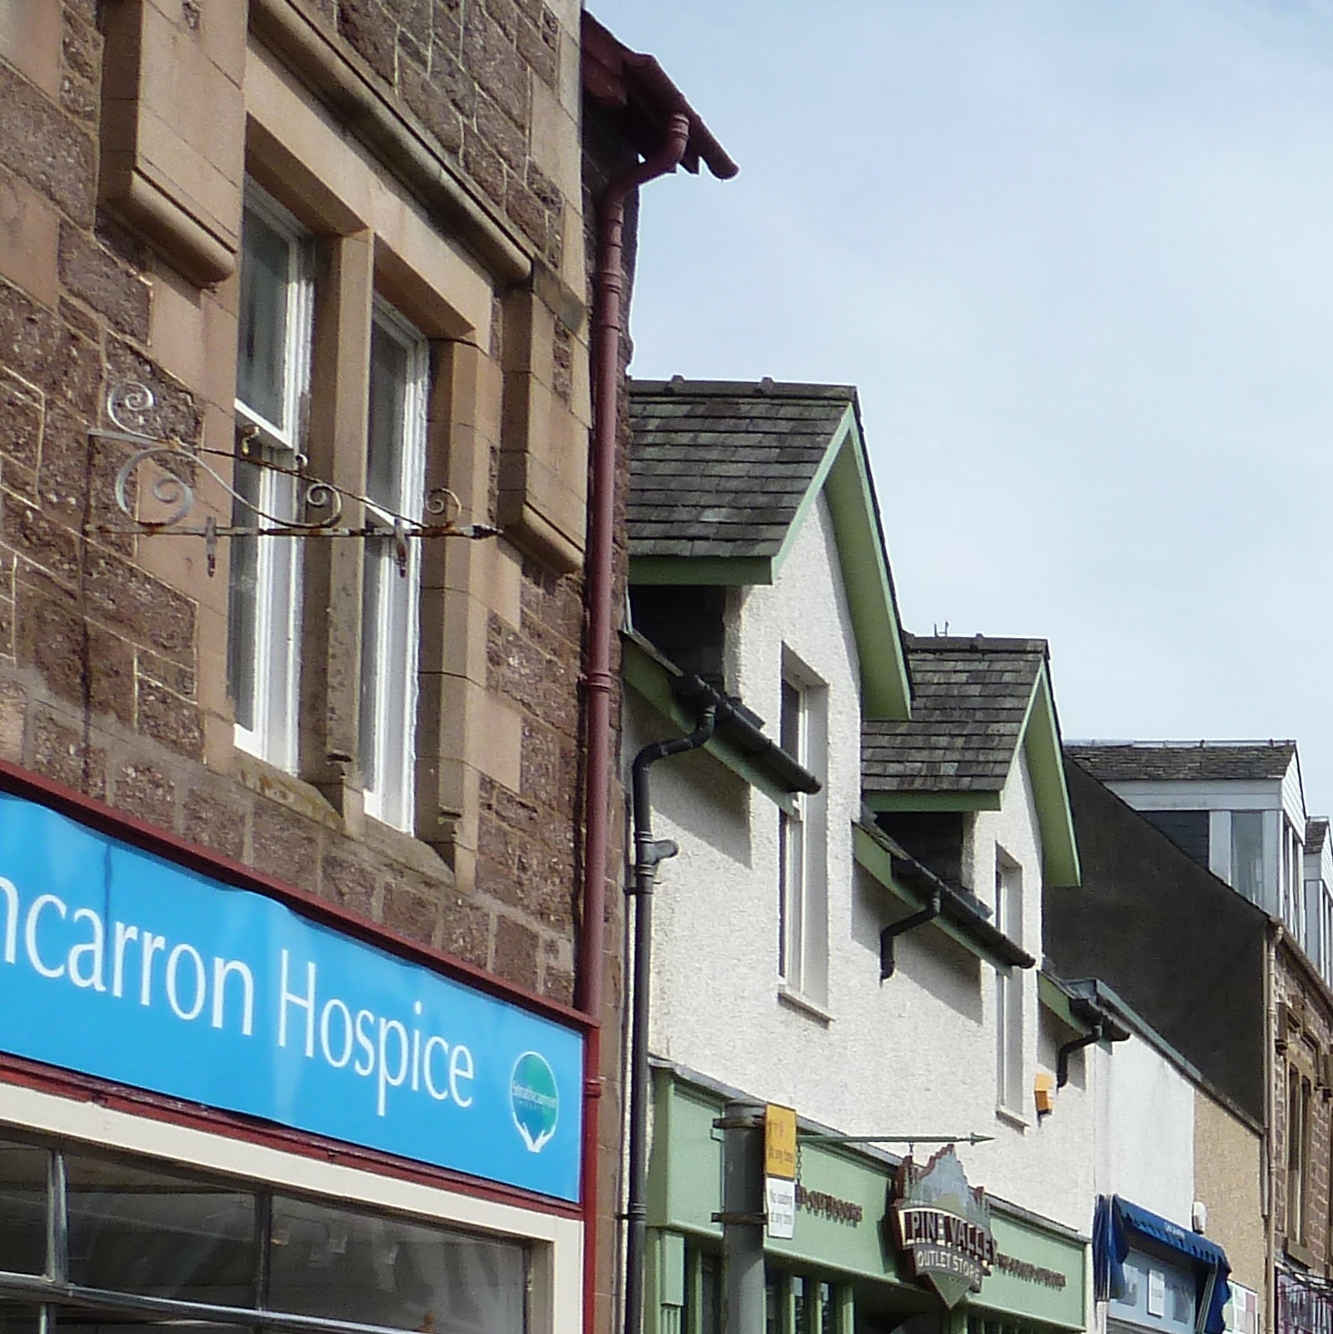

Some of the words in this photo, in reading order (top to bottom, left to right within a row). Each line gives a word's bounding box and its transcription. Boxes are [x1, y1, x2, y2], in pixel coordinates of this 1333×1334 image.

[278, 948, 475, 1117] Hospice
[911, 1211, 945, 1243] PINE
[949, 1217, 997, 1266] VALLEY
[917, 1250, 951, 1268] OUTLET
[952, 1257, 981, 1285] STORE
